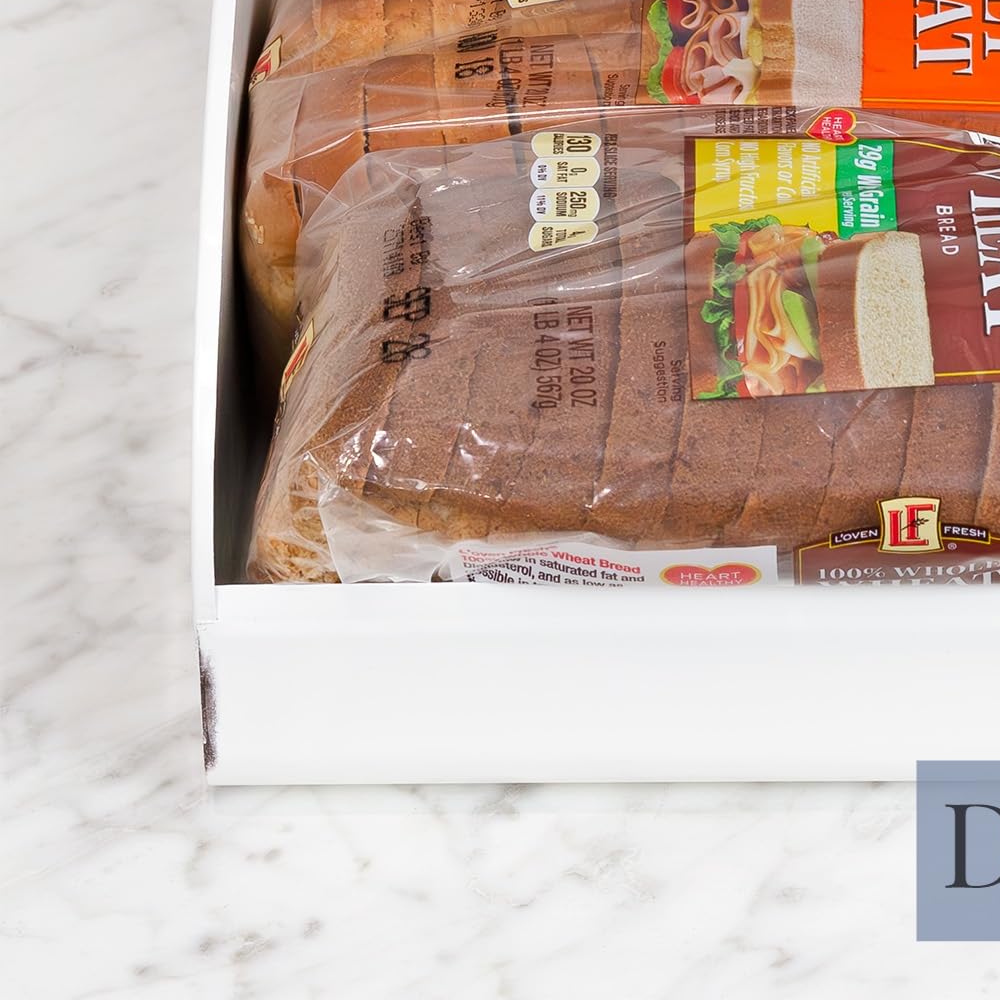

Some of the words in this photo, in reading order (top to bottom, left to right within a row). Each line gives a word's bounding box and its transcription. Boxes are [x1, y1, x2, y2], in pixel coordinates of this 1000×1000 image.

[499, 48, 524, 64] LB
[530, 44, 554, 68] NET
[455, 57, 495, 79] 18
[528, 71, 553, 87] WT
[553, 133, 564, 154] CALORIES
[566, 135, 592, 152] 130
[557, 161, 568, 172] SAT
[603, 147, 617, 165] SLICE
[736, 153, 760, 170] High
[776, 142, 796, 169] Flavors
[854, 144, 884, 171] 29g
[557, 173, 568, 183] FAT
[602, 167, 618, 198] SERVING
[777, 170, 793, 184] or
[556, 192, 567, 217] SODIUM
[567, 191, 587, 217] 250mg
[841, 197, 857, 228] Serving
[859, 189, 885, 228] Grain
[934, 204, 960, 256] BREAD
[532, 311, 558, 329] LB
[567, 305, 594, 334] NET
[534, 334, 560, 344] 4
[569, 337, 595, 361] WT
[531, 348, 561, 371] OZ)
[570, 366, 596, 385] 20
[653, 341, 669, 404] Suggestion
[670, 360, 683, 401] Serving
[532, 375, 562, 409] 567g
[571, 389, 598, 408] OZ
[834, 529, 878, 544] L'OVEN
[943, 526, 987, 539] FRESH
[524, 556, 537, 565] in
[539, 559, 598, 579] saturated
[600, 571, 619, 583] fat
[621, 575, 645, 583] and
[551, 551, 597, 567] Wheat
[599, 558, 641, 575] Bread
[818, 566, 887, 580] 100%
[538, 571, 561, 584] and
[564, 578, 580, 586] as
[680, 571, 741, 581] HEART
